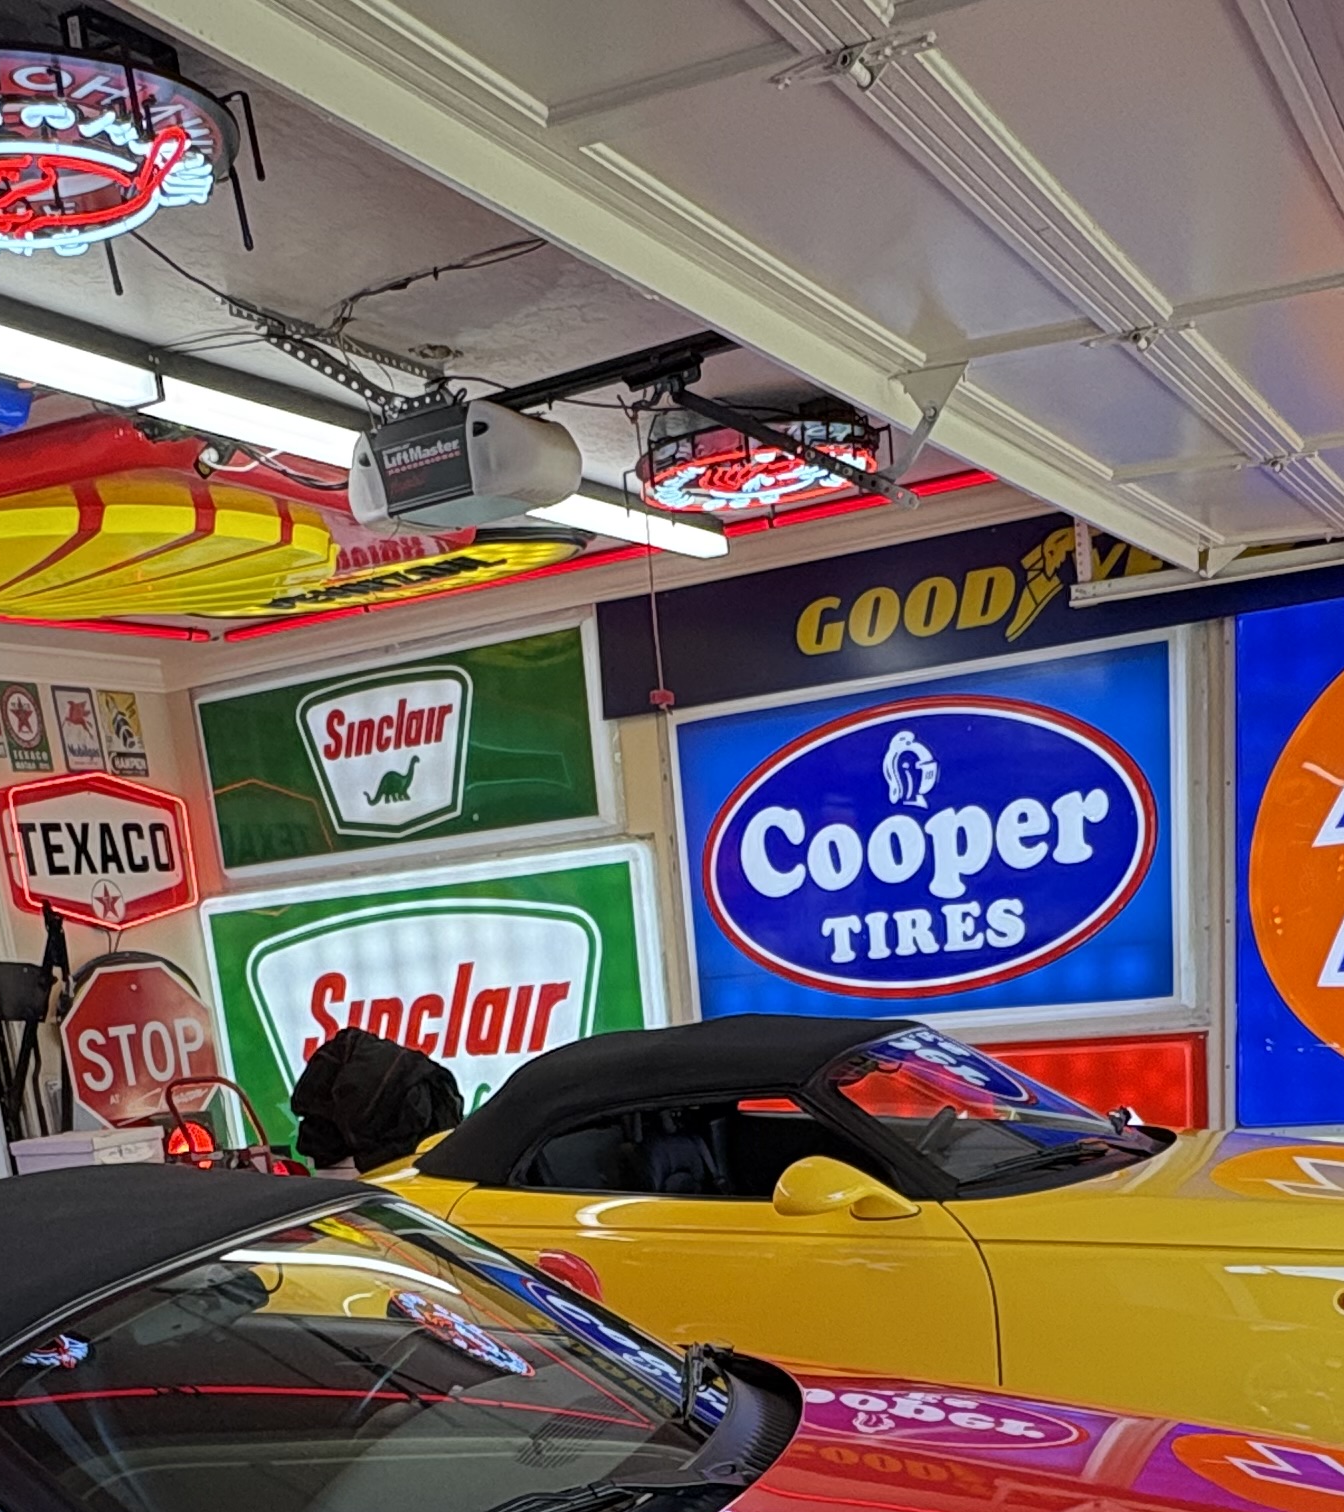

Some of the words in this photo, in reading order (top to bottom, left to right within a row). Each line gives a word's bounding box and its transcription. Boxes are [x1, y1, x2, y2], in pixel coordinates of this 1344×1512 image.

[382, 439, 460, 470] LiftMaster
[796, 568, 1016, 656] GOOD
[13, 750, 49, 760] TEXACO
[324, 699, 454, 761] Sinclair
[17, 822, 176, 878] TEXACO
[740, 788, 1110, 899] Cooper
[821, 899, 1026, 964] TIRES
[77, 1018, 205, 1093] STOP
